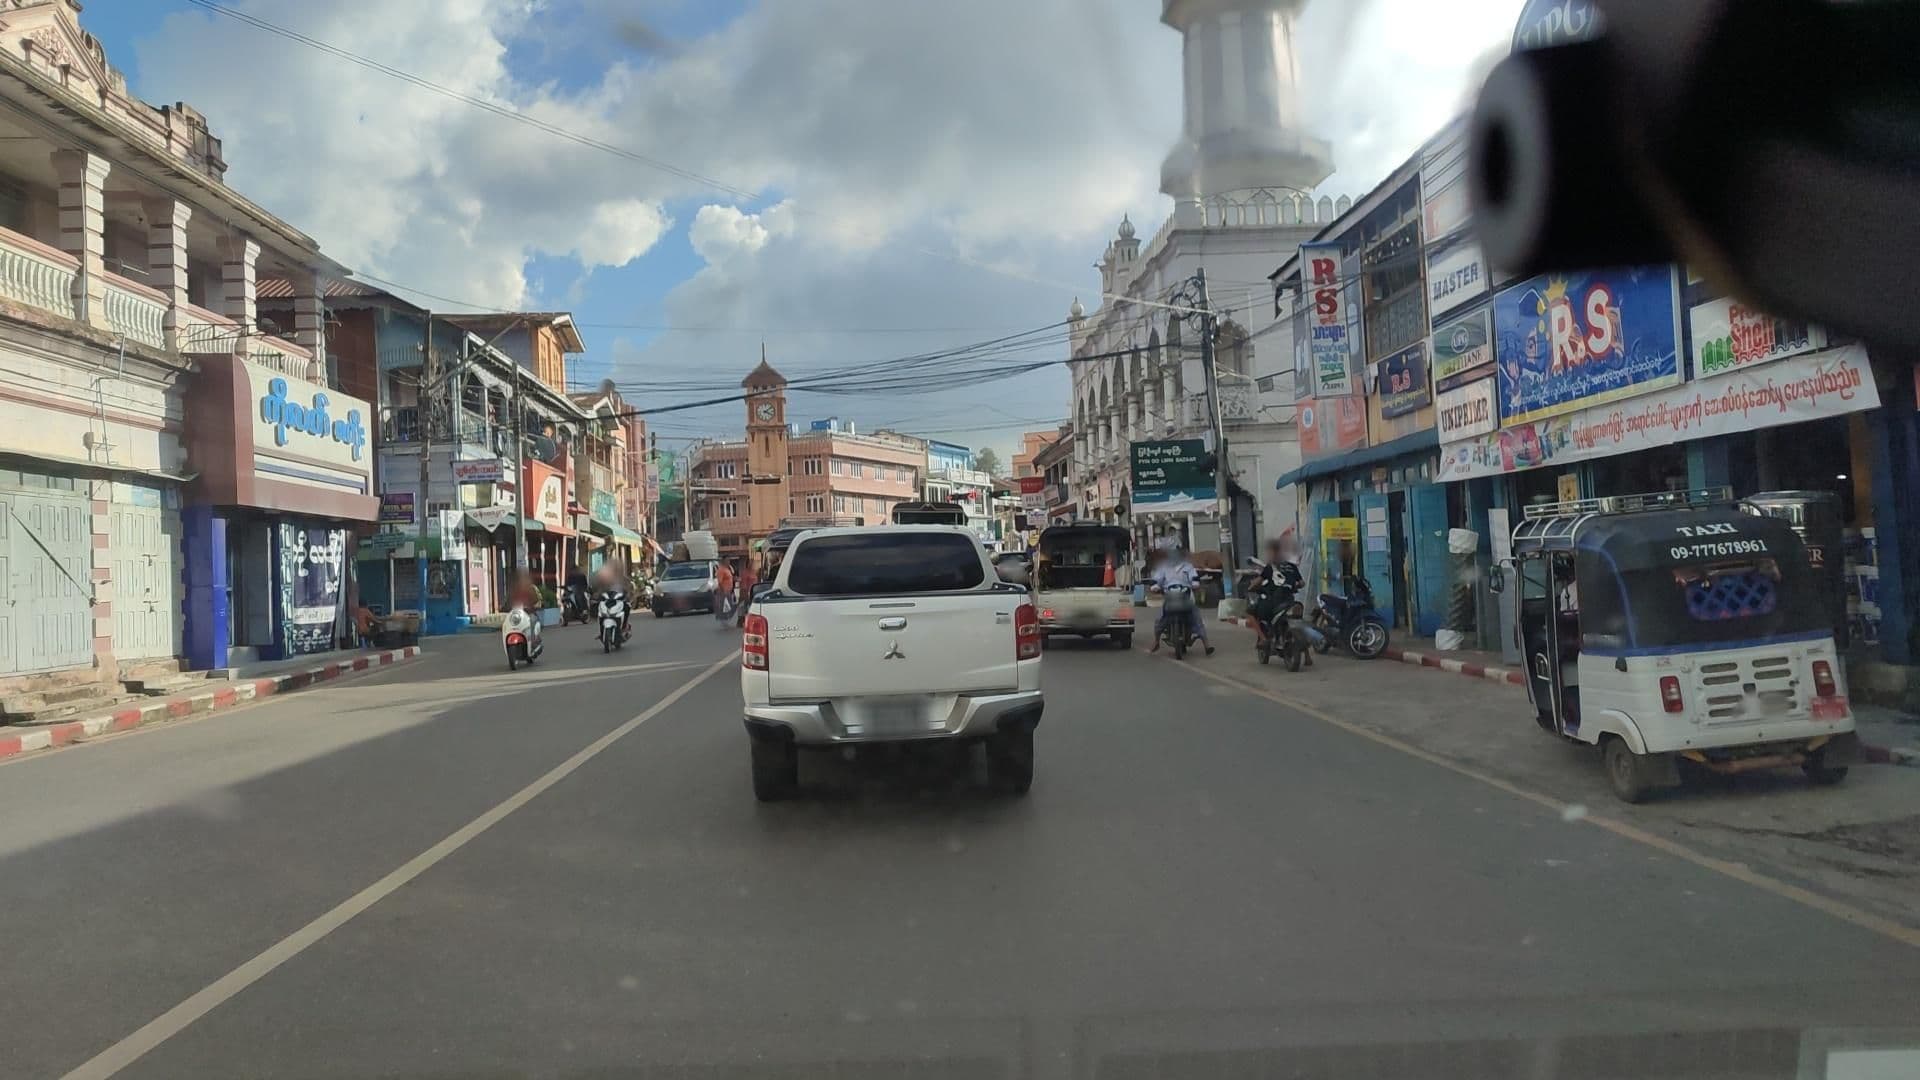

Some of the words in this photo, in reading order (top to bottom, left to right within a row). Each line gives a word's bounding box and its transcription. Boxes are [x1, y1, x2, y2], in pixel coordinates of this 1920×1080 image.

[1433, 261, 1479, 300] MASTER
[1676, 523, 1739, 537] TAXI
[1670, 540, 1768, 559] 09-777678961
